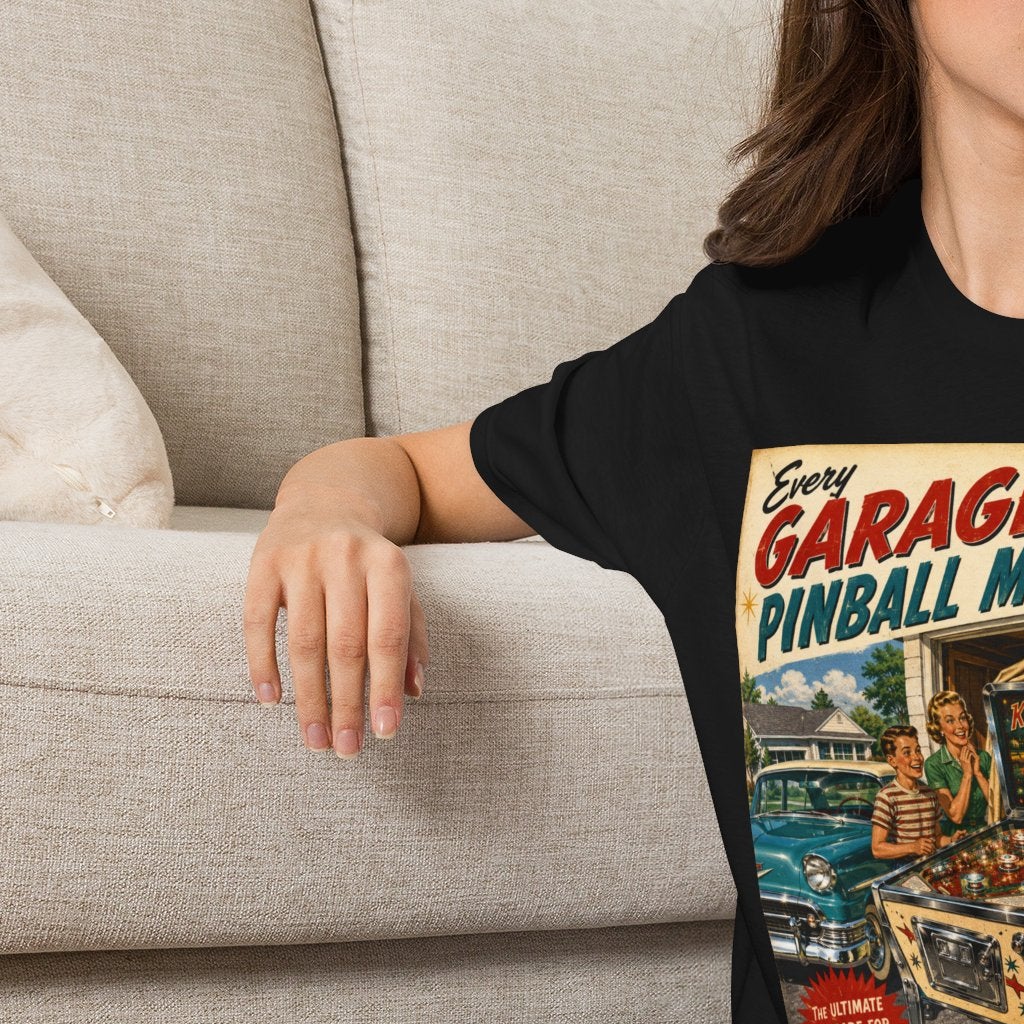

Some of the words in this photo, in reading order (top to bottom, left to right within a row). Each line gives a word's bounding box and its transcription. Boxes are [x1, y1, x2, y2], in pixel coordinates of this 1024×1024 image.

[762, 459, 858, 514] Every
[757, 555, 961, 663] PINBALL
[812, 1006, 828, 1021] THE
[829, 996, 884, 1018] ULTIMATE
